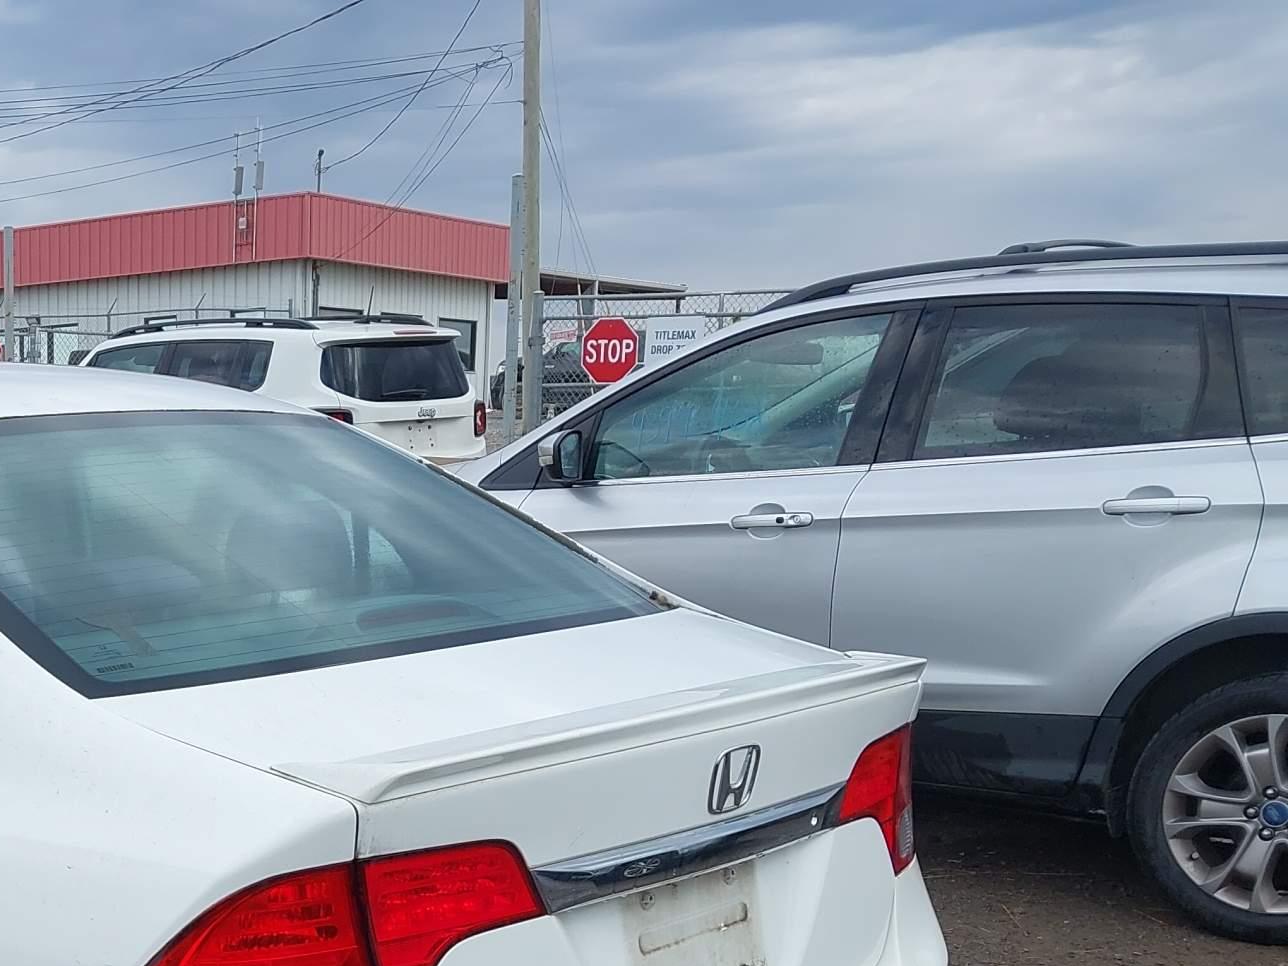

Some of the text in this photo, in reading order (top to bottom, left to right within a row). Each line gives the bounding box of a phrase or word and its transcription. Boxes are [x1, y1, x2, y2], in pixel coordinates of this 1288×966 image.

[655, 330, 697, 340] TITLEMAX
[585, 339, 634, 364] STOP
[650, 344, 674, 355] DROP
[417, 406, 437, 418] Jeep
